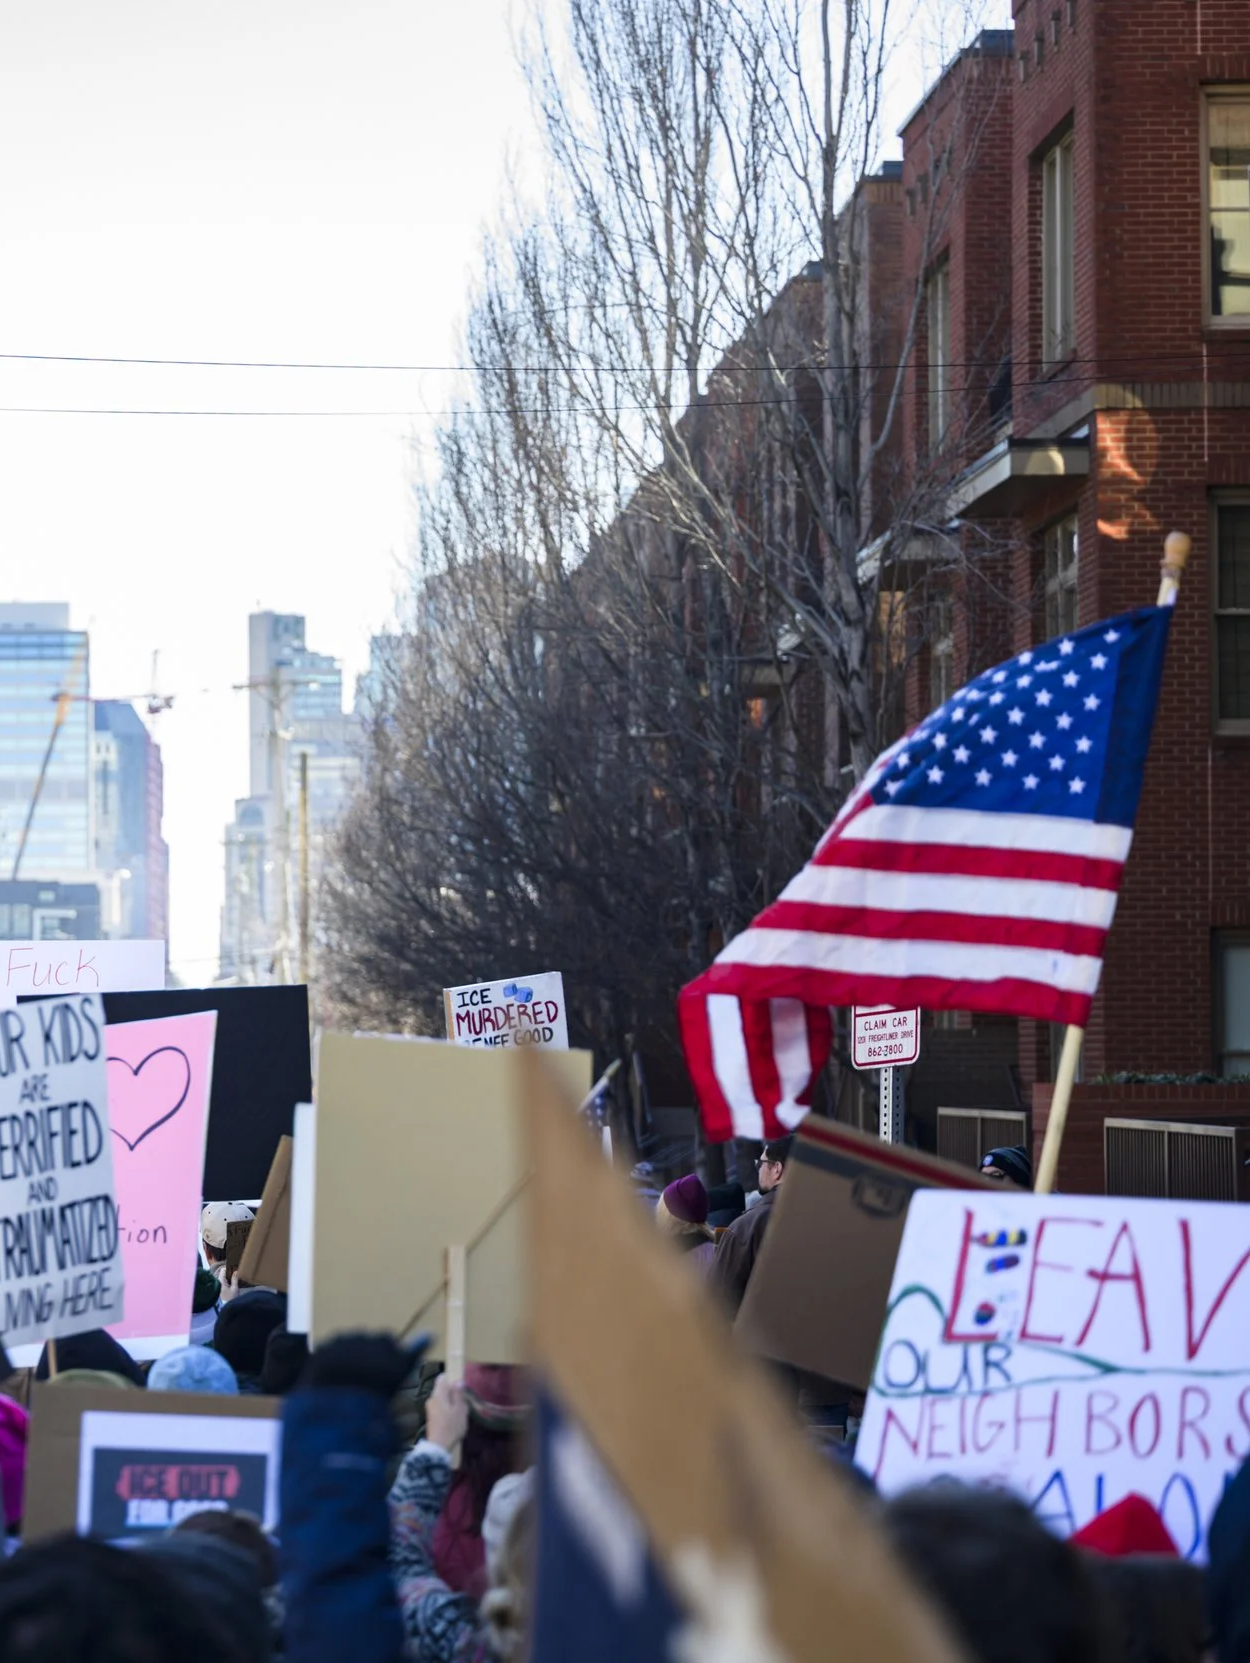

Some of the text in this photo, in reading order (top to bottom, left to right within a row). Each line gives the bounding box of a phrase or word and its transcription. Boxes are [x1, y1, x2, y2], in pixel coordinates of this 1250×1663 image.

[6, 946, 100, 988] Fuck
[456, 987, 492, 1009] ICE
[37, 996, 100, 1068] KIDS
[455, 1000, 559, 1037] MURDERED
[863, 1016, 908, 1031] CLAIM CAR
[513, 1027, 554, 1047] GOOD
[868, 1031, 898, 1043] FREIGHTLINER
[900, 1029, 914, 1039] DRIVE
[19, 1073, 51, 1103] ARE
[27, 1177, 59, 1204] AND
[58, 1266, 114, 1319] HERE
[943, 1205, 1250, 1361] LEAV
[883, 1339, 1012, 1394] OUR
[126, 1467, 230, 1498] ICE OUT
